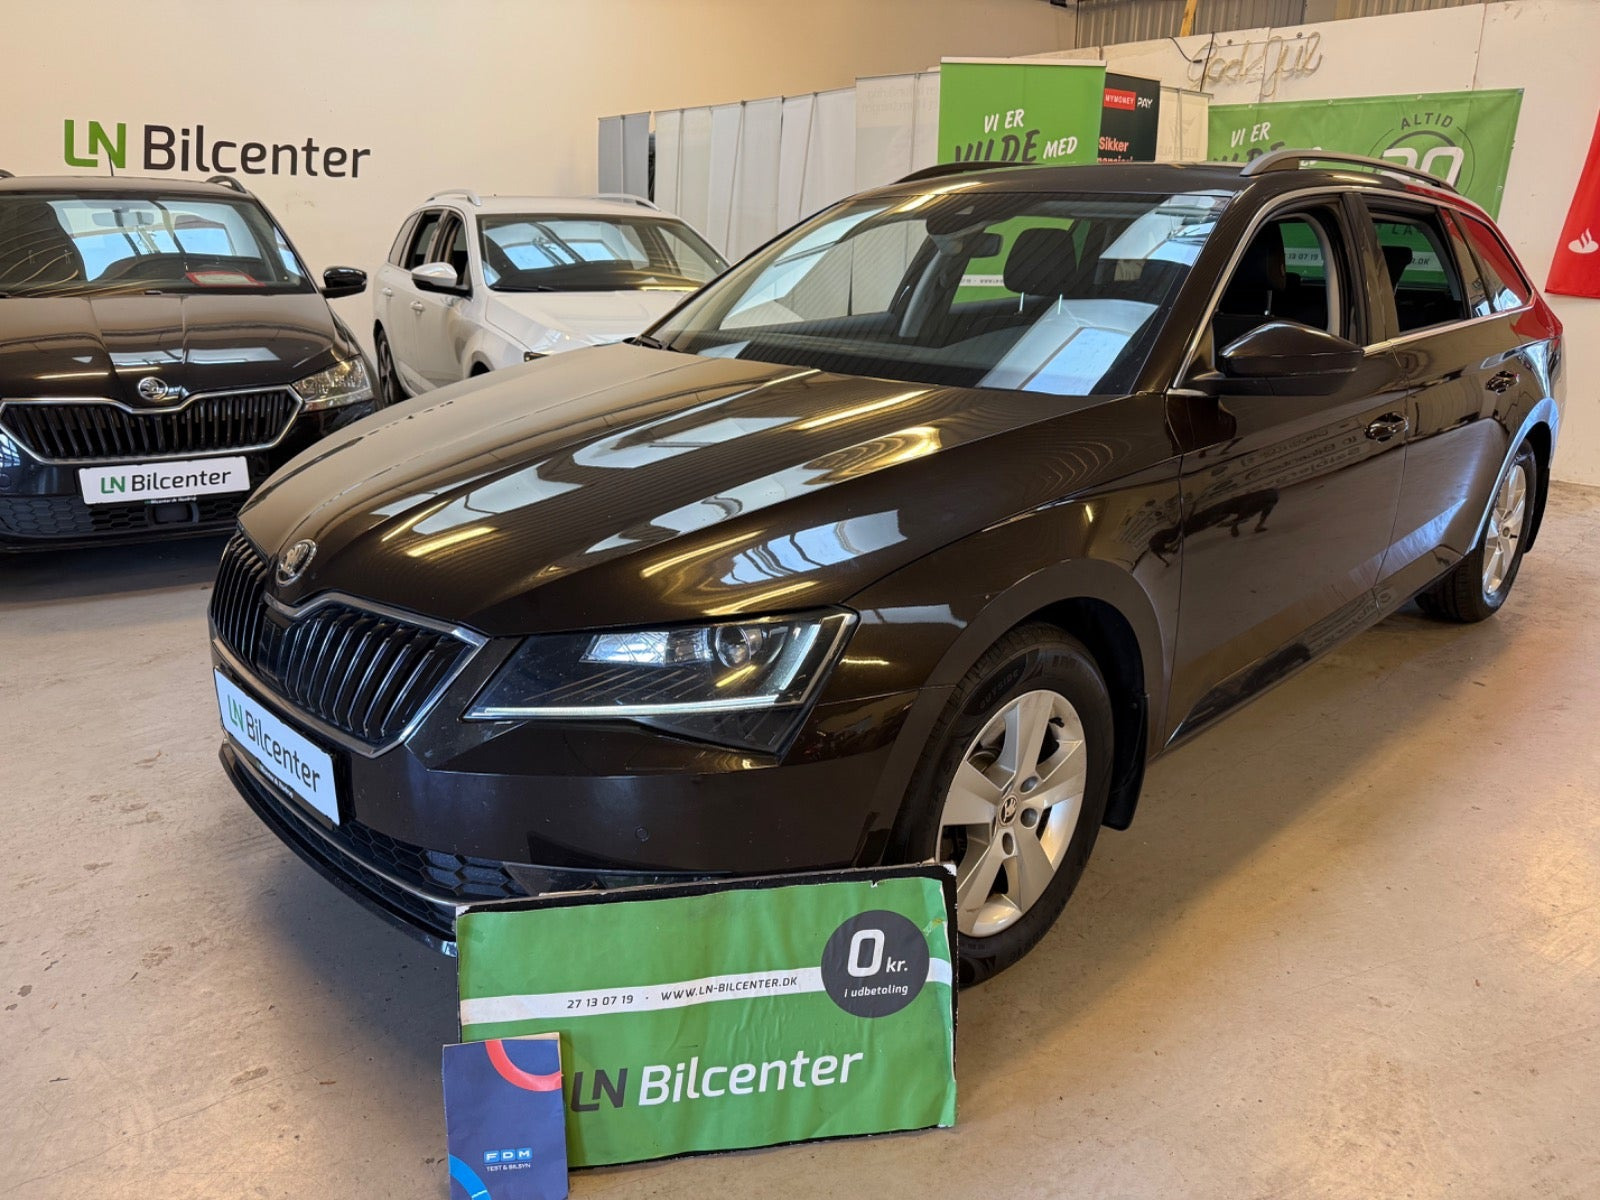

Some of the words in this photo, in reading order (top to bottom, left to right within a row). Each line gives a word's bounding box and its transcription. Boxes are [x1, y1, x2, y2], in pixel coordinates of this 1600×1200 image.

[1137, 96, 1153, 108] PAY
[984, 113, 999, 134] VI
[1004, 108, 1024, 129] ER
[1400, 112, 1454, 130] ALTID
[1098, 136, 1129, 152] Sikker
[1230, 128, 1246, 148] VI
[1250, 121, 1271, 142] ER
[64, 119, 127, 169] LN
[143, 124, 371, 178] Bilcenter
[1042, 136, 1078, 160] MED
[101, 476, 126, 494] LN
[131, 470, 232, 492] Bilcenter
[227, 694, 244, 732] LN
[245, 710, 321, 793] Bilcenter
[847, 929, 885, 977] 0
[886, 957, 908, 973] kr.
[567, 1000, 581, 1009] 27
[586, 998, 598, 1007] 13
[602, 996, 617, 1006] 07
[622, 995, 634, 1004] 19
[661, 976, 798, 1001] WWW.LN-BILCENTER.DK
[851, 984, 909, 997] udbetaling
[571, 1067, 628, 1113] LN
[638, 1051, 864, 1106] Bilcenter
[486, 1150, 530, 1161] FDM
